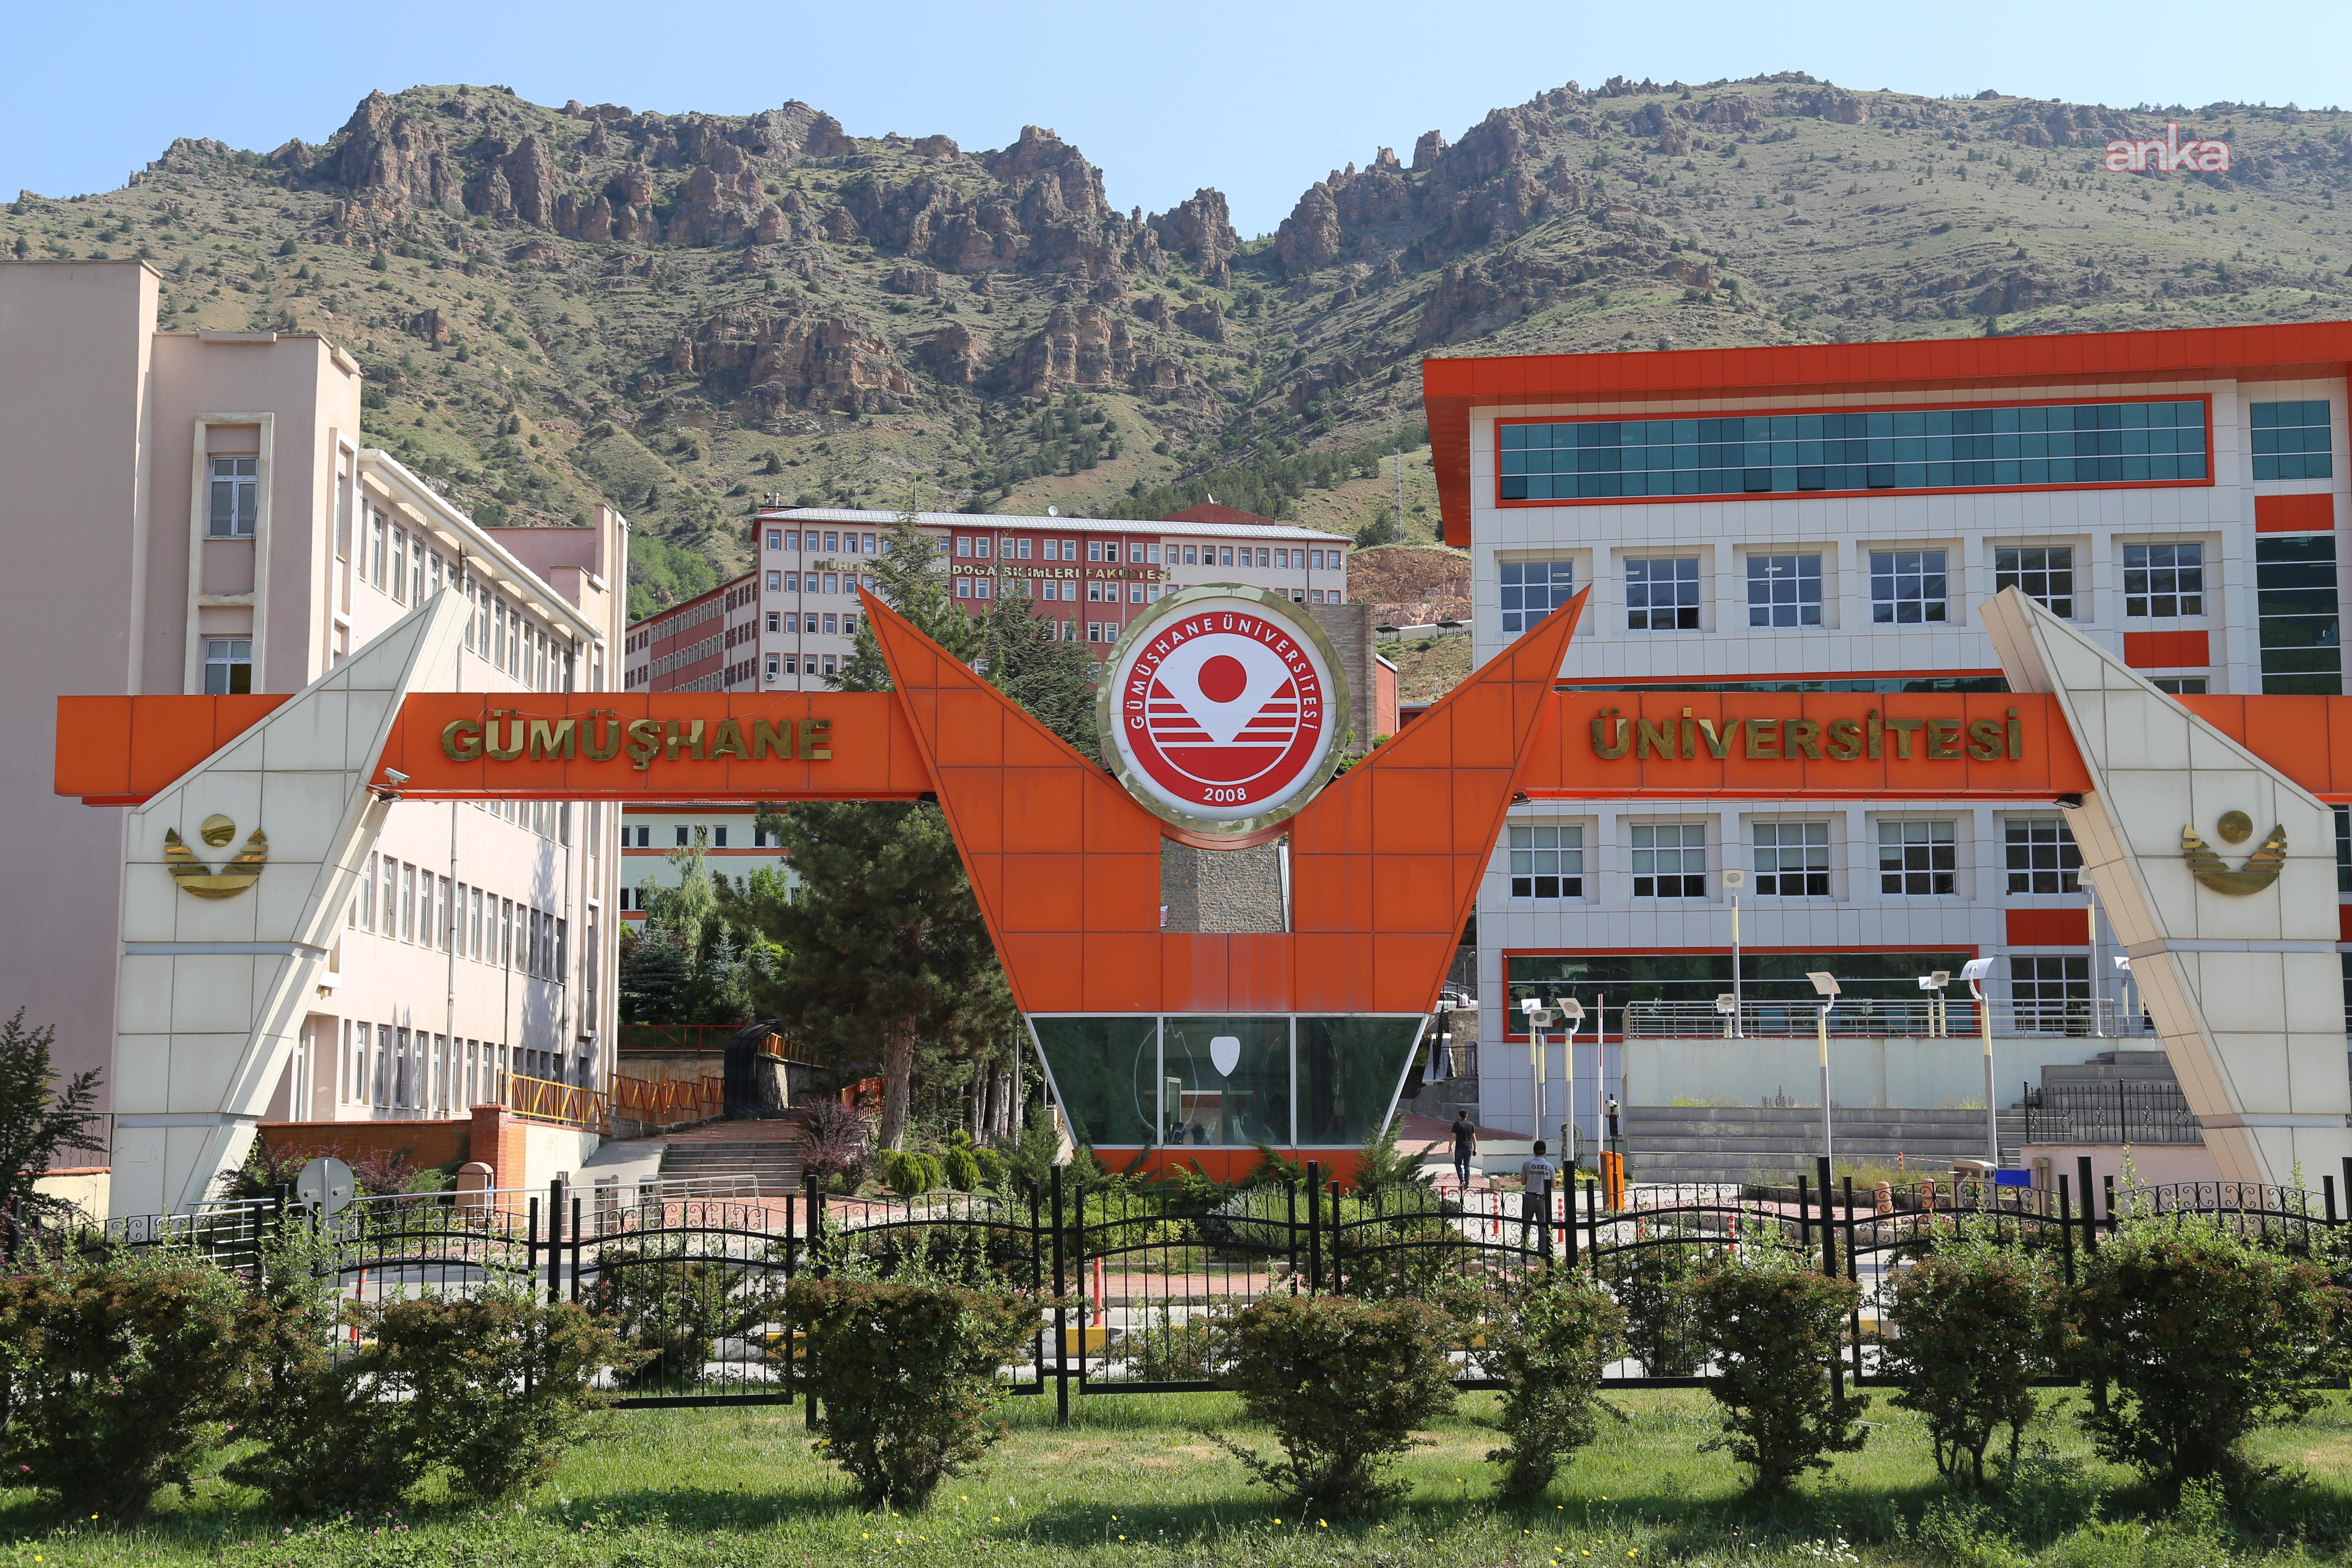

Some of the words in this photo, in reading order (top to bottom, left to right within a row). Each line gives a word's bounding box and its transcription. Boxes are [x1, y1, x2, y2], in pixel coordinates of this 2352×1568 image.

[952, 562, 997, 576] DOĞA
[1086, 566, 1171, 581] FAKÜLTESİ
[1126, 617, 1213, 729] GÜMÜŞHANE
[1222, 614, 1318, 729] ÜNİVERSİTESİ
[441, 709, 832, 770] GÜMÜŞHANE
[1591, 708, 2022, 760] ÜNİVERSİTESİ
[1203, 787, 1247, 802] 2008
